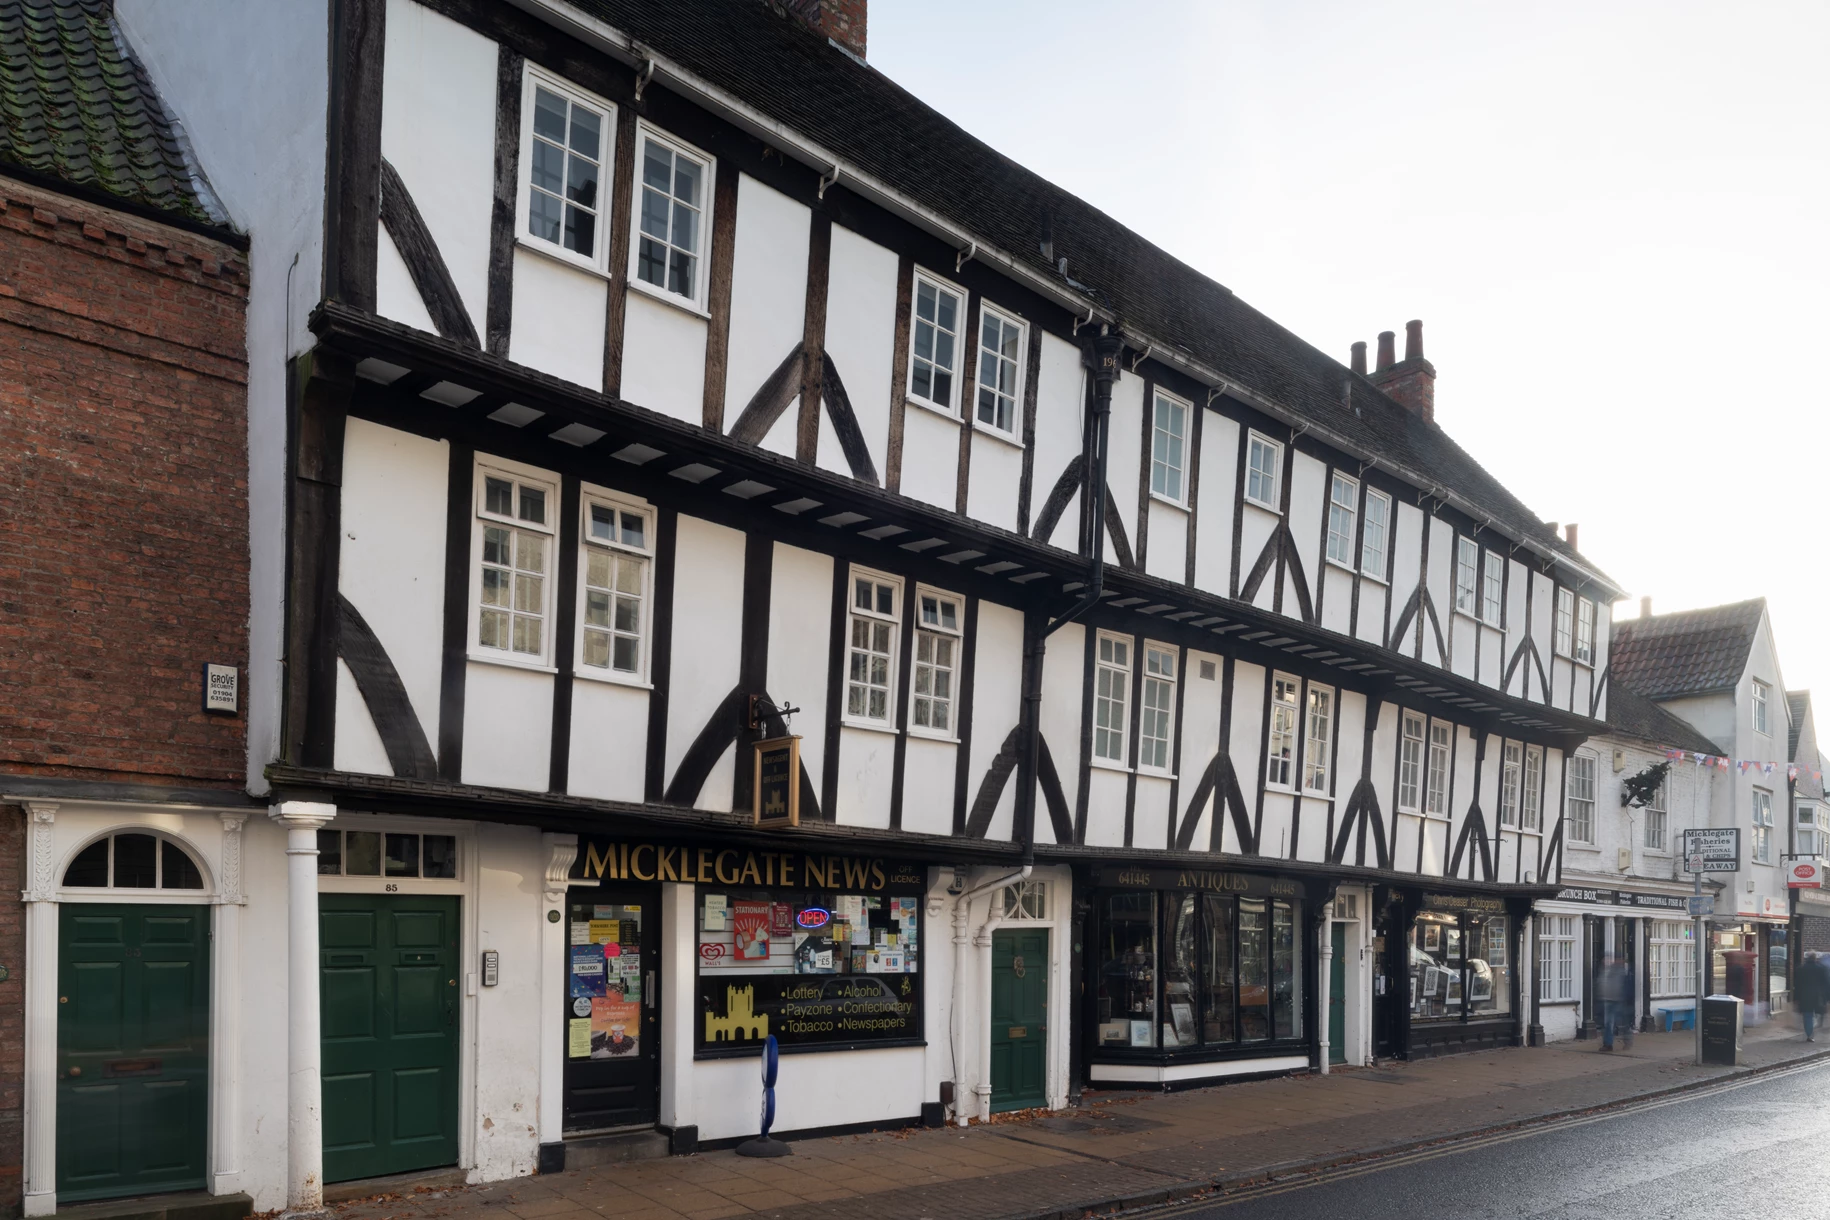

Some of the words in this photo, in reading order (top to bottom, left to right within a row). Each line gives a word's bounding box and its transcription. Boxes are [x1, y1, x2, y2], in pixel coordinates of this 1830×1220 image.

[211, 674, 235, 686] GROVE
[1686, 830, 1734, 838] Micklegate
[583, 842, 794, 886] MICKLEGATE
[804, 856, 885, 890] NEWS
[898, 866, 912, 874] OFF
[890, 874, 920, 884] LICENCE
[1118, 872, 1150, 886] 641445
[1178, 870, 1249, 892] ANTIQUES
[1270, 883, 1295, 895] 641445
[1584, 890, 1597, 900] BOX
[1470, 896, 1502, 911] Photography
[1637, 896, 1667, 906] TRADITIONAL
[735, 906, 768, 914] STATIONARY
[800, 911, 827, 924] OPEN
[787, 987, 824, 1001] Lottery
[844, 986, 880, 998] Alcohol
[787, 1004, 832, 1018] Payzone
[844, 1002, 912, 1014] Confectionary
[788, 1020, 833, 1032] Tobacco
[843, 1018, 905, 1031] Newspapers
